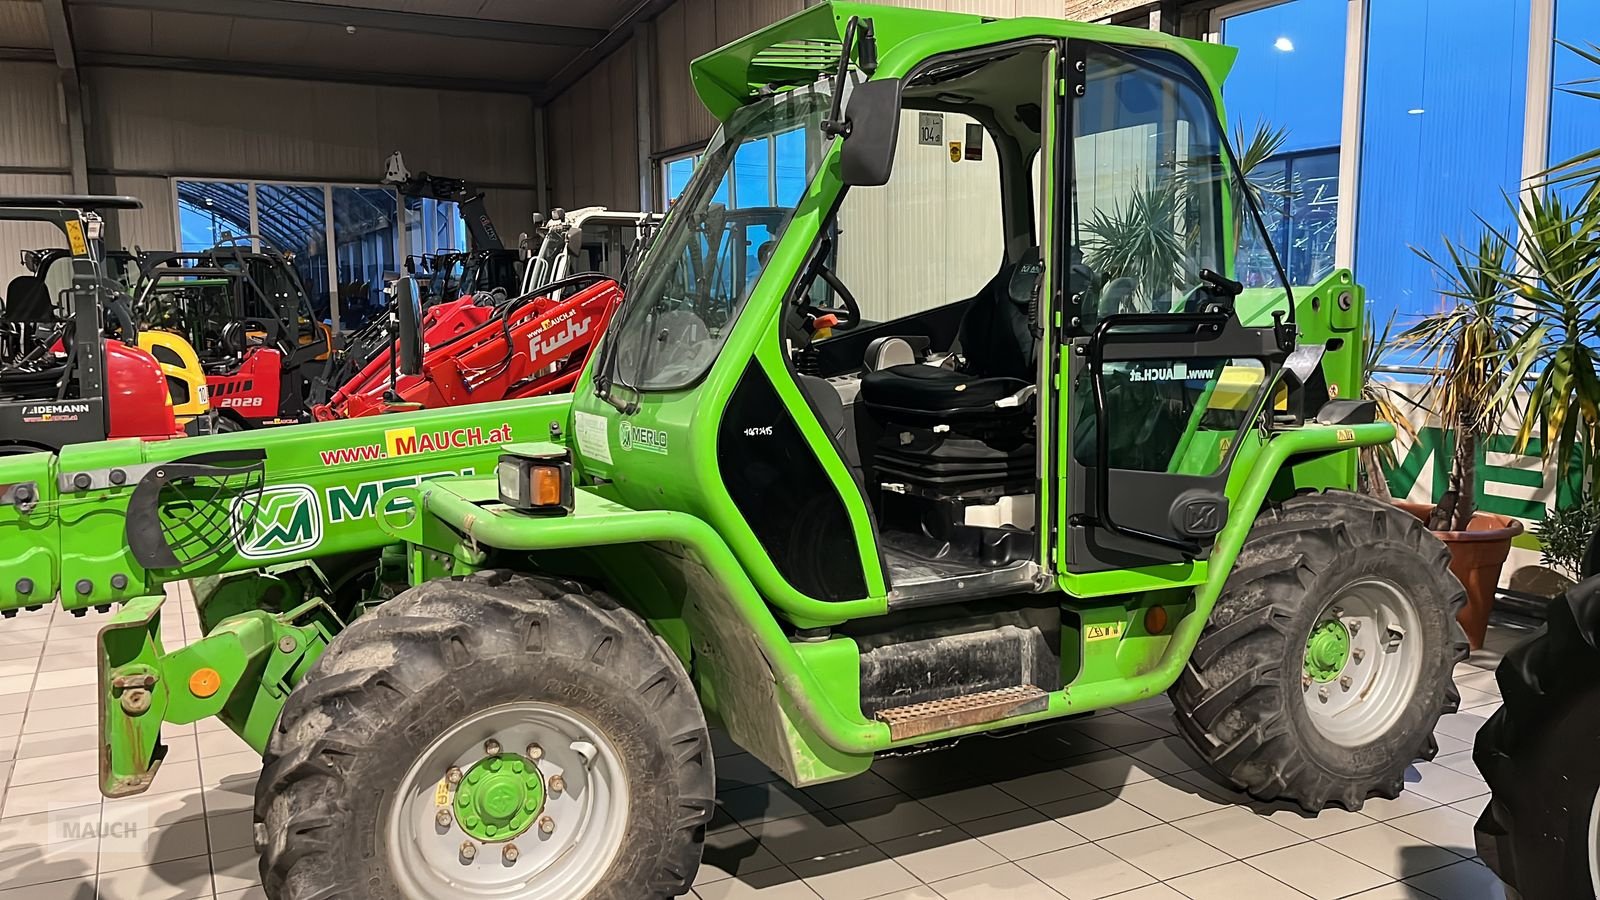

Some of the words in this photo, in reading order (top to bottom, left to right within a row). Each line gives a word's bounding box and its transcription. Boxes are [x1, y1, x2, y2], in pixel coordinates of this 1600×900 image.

[921, 126, 934, 142] 104
[529, 316, 591, 362] Fuchs
[221, 397, 263, 408] 2028
[320, 423, 512, 466] www.MAUCH.at
[632, 426, 668, 448] MERLO
